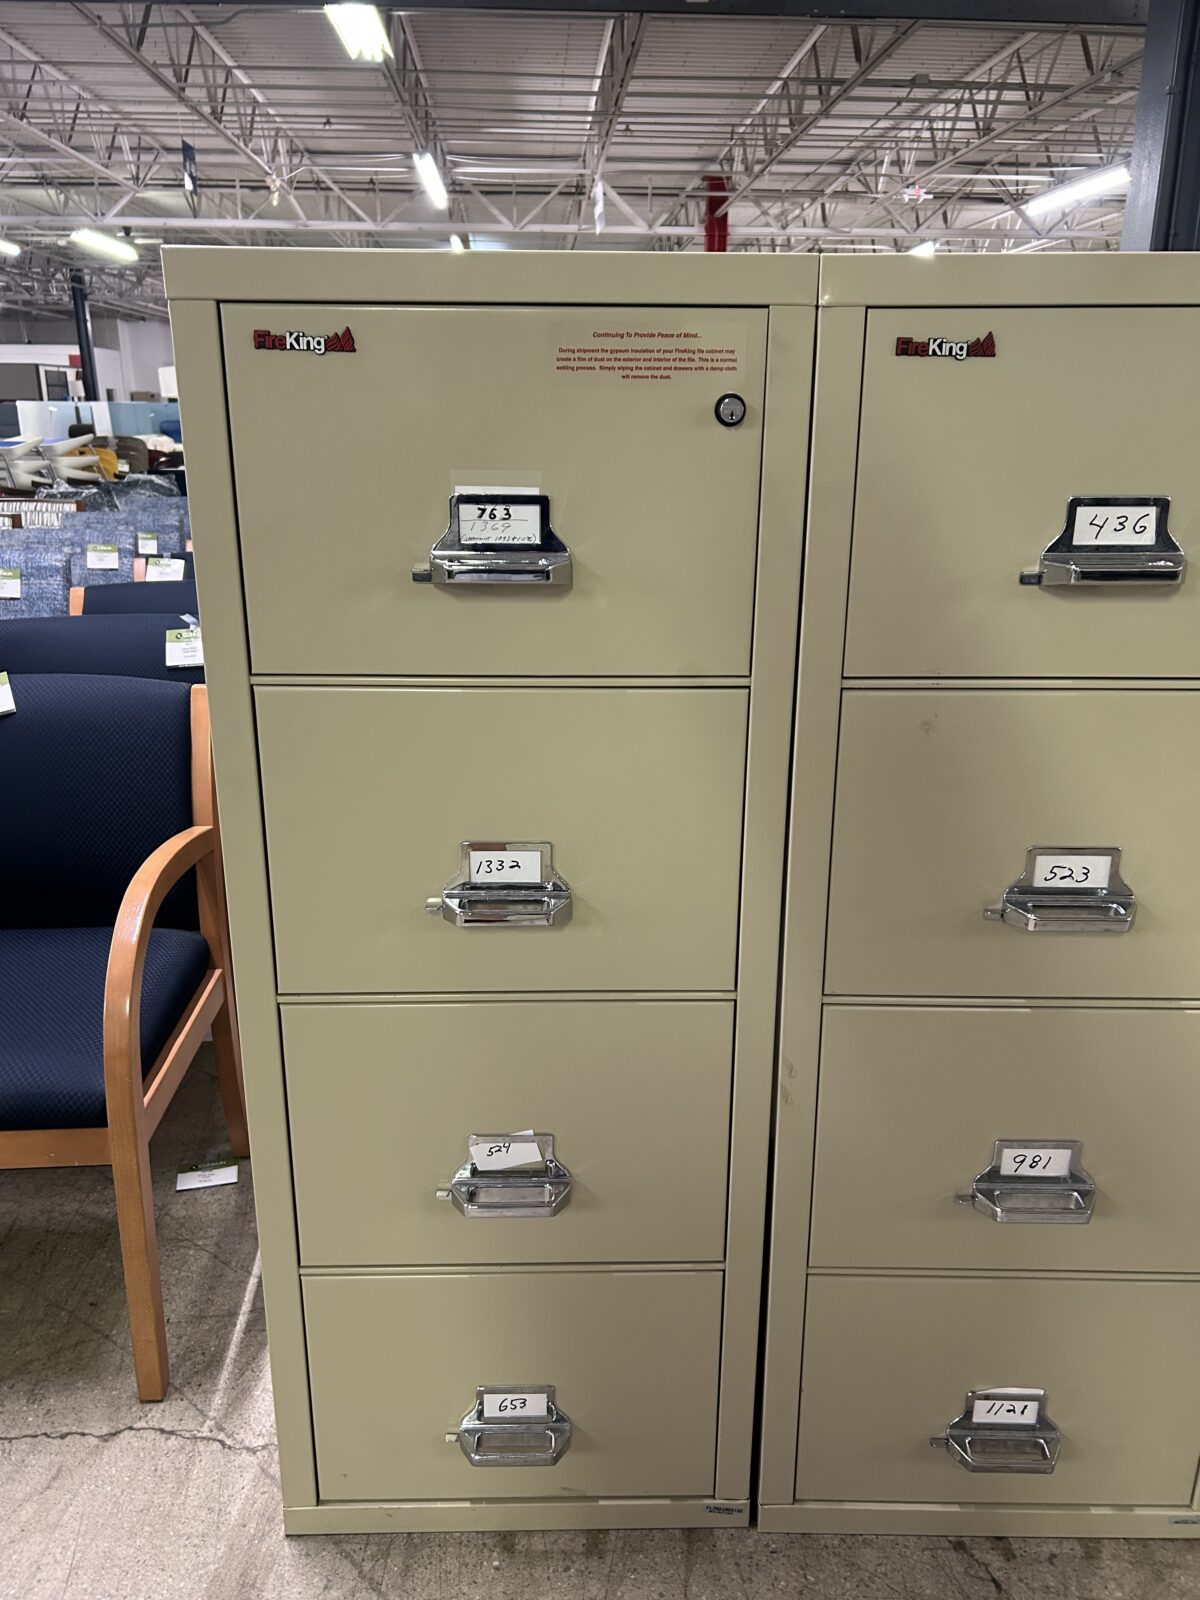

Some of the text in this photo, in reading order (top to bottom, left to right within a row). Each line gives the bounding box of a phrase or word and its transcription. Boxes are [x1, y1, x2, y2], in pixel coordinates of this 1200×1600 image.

[253, 329, 326, 355] FireKing
[895, 336, 968, 361] FireKing
[477, 507, 512, 520] 763
[1089, 514, 1150, 540] 436
[476, 860, 521, 874] 1332
[1044, 866, 1090, 882] 523
[1013, 1154, 1052, 1172] 981
[498, 1398, 528, 1412] 653
[986, 1402, 1028, 1416] 1121
